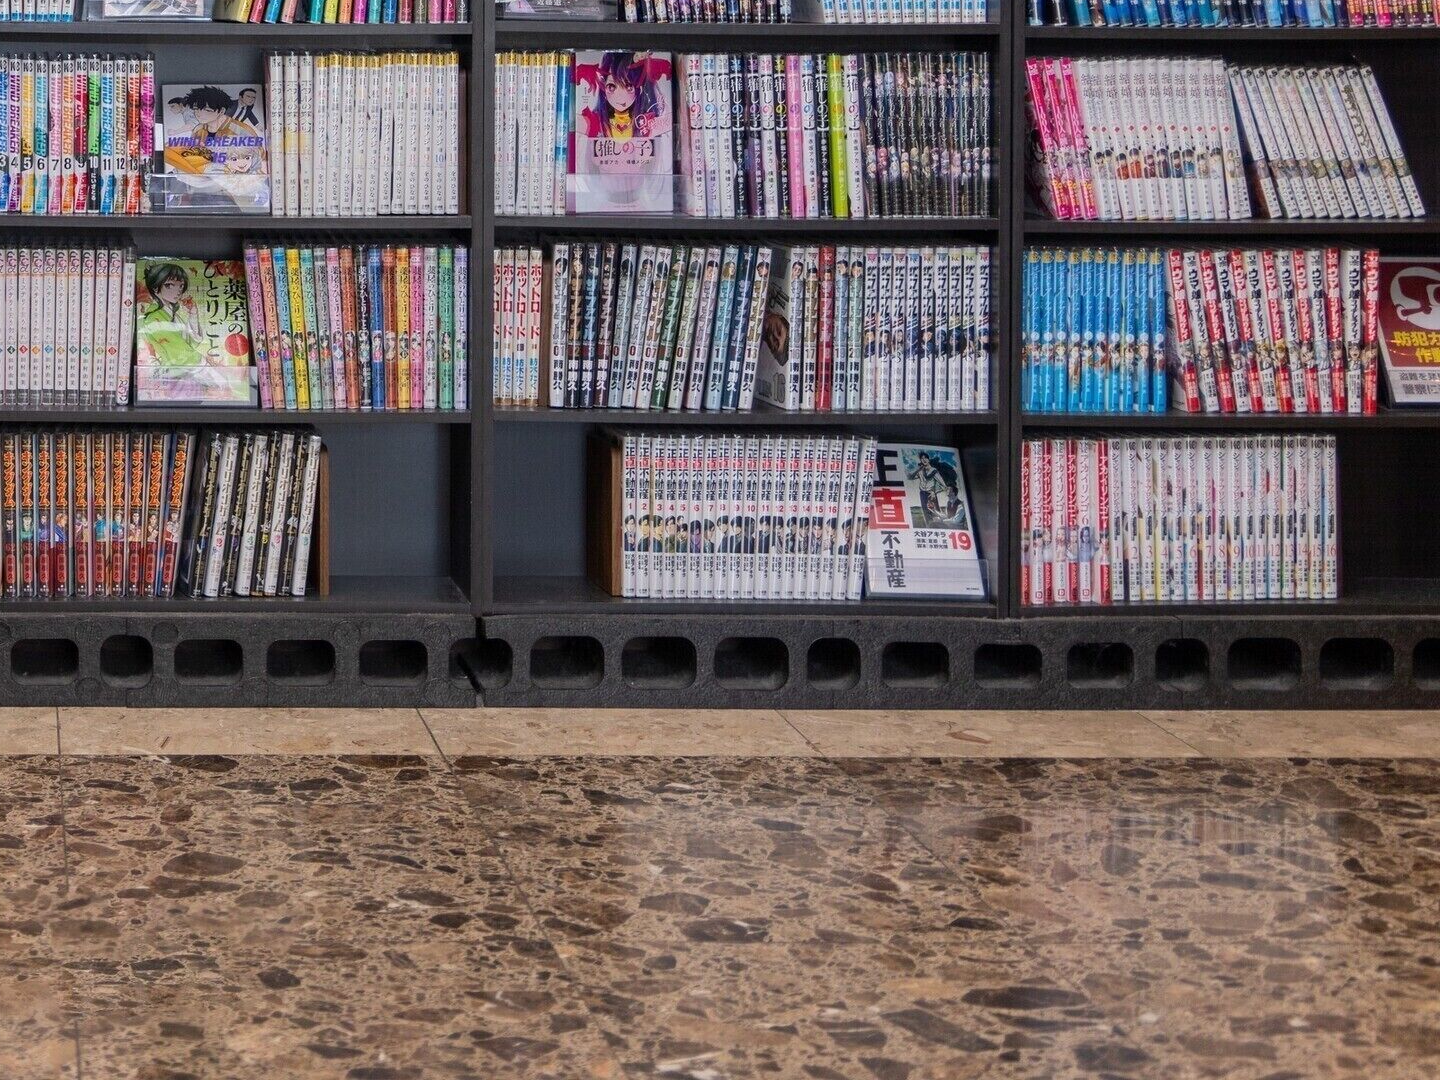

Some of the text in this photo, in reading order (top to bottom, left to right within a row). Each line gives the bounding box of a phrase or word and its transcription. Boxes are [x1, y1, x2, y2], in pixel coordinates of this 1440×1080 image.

[168, 137, 264, 147] WIND BREAKER
[593, 139, 655, 157] 【推しの子】
[11, 157, 19, 168] 4
[64, 157, 71, 168] 8
[203, 261, 224, 357] ひとりごと
[224, 279, 247, 333] 薬屋の
[517, 265, 527, 338] ホットロード
[530, 264, 541, 338] ホットロード
[1402, 384, 1440, 395] 警察に
[639, 448, 649, 499] 正直不動産
[666, 448, 677, 500] 正直不動産
[746, 449, 757, 501] 正直不動産
[761, 449, 772, 501] 正直不動産
[1035, 517, 1042, 527] 2
[1082, 517, 1089, 527] 6
[949, 532, 971, 550] 19
[1115, 545, 1120, 557] 1
[1146, 546, 1153, 558] 3
